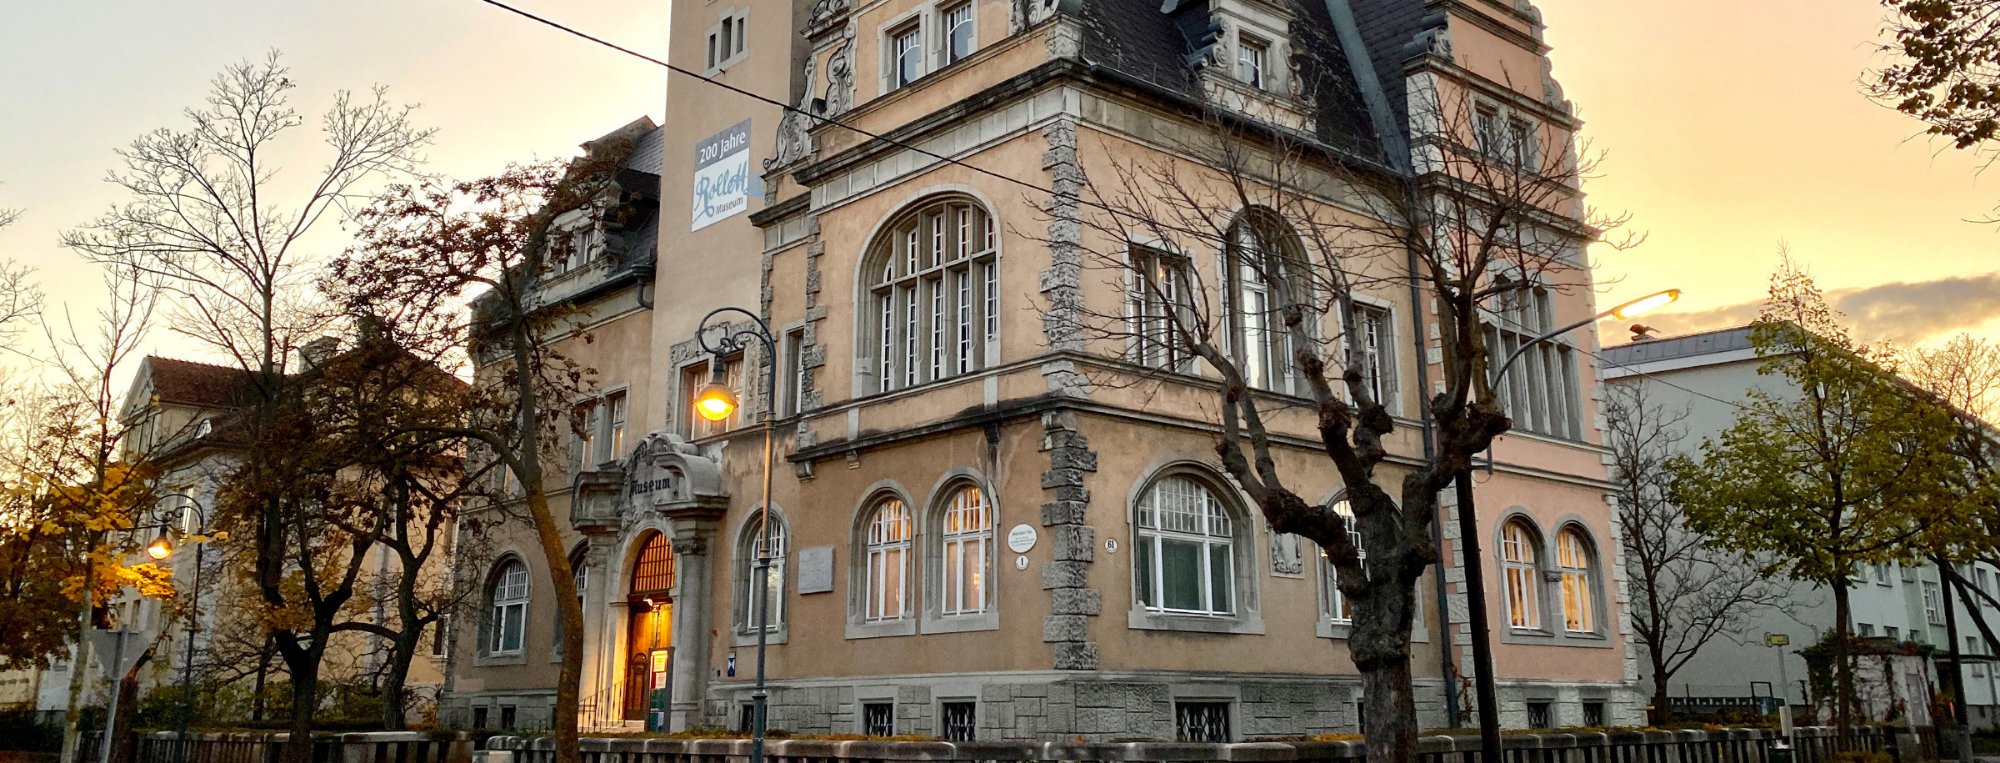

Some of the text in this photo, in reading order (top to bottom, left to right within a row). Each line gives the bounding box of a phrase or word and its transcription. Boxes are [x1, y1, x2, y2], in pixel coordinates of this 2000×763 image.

[700, 131, 746, 164] 200 Jahre
[693, 161, 748, 218] Rollett
[715, 197, 744, 215] Museum
[629, 478, 670, 498] Museum
